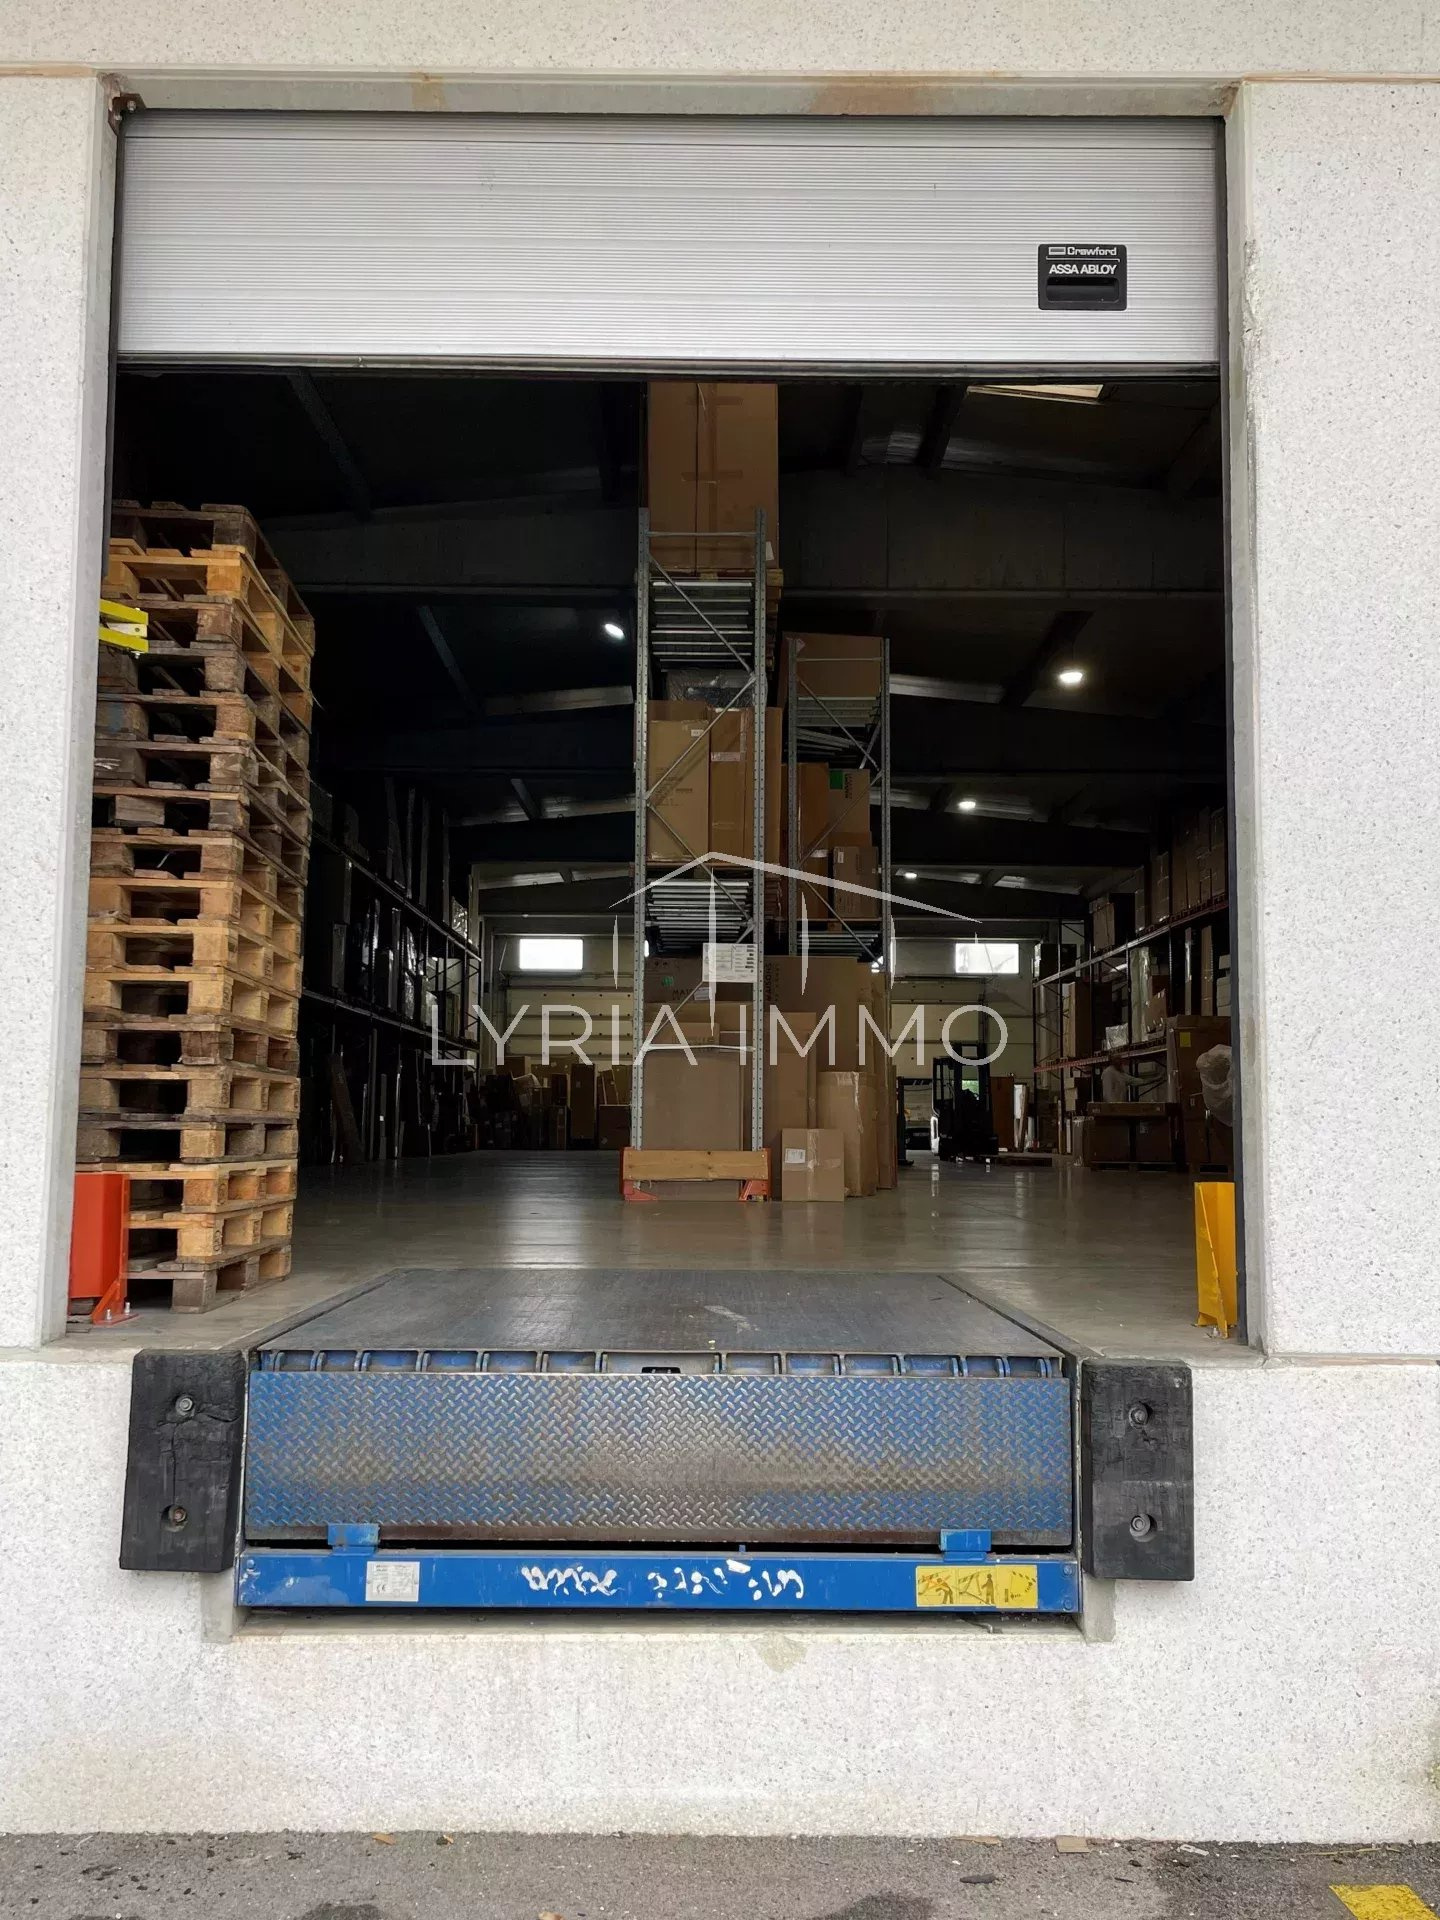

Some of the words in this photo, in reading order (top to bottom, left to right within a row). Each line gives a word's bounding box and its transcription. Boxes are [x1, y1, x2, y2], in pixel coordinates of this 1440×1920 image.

[1067, 246, 1117, 256] Crawford
[1049, 264, 1079, 275] ASSA
[1080, 264, 1117, 275] ABLOY
